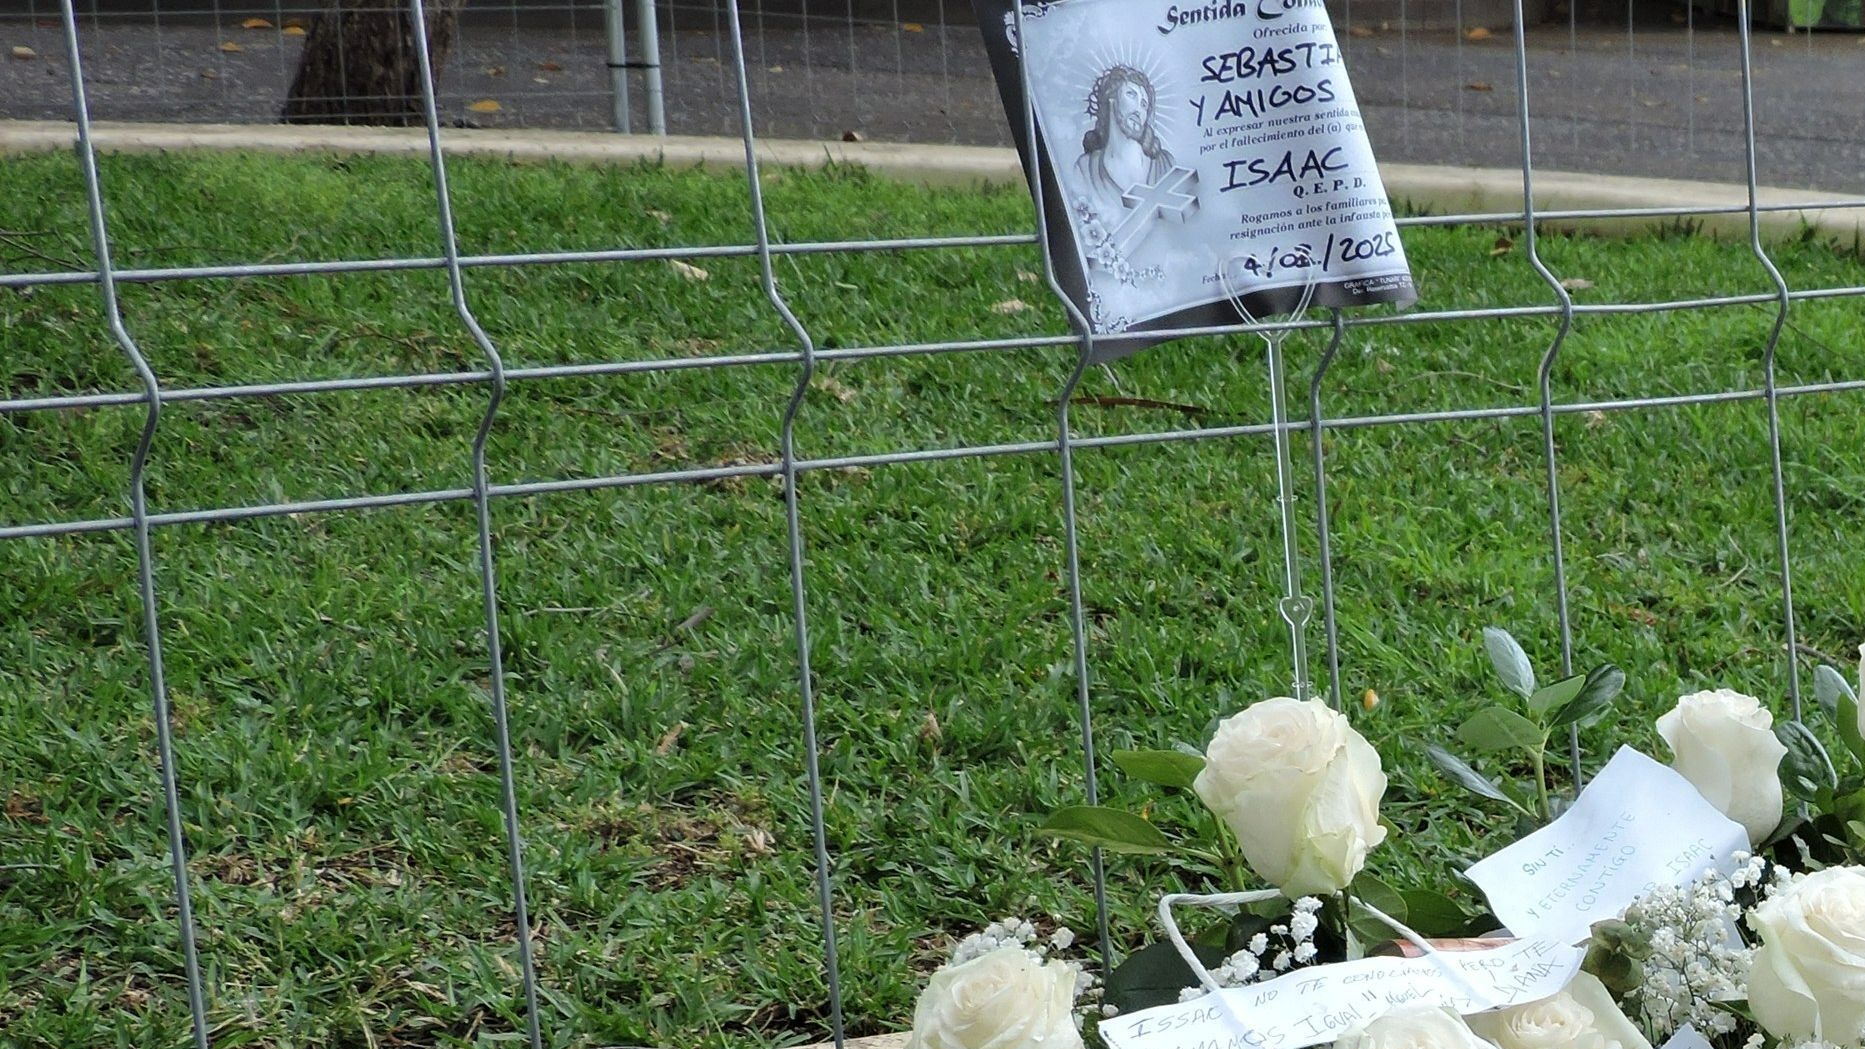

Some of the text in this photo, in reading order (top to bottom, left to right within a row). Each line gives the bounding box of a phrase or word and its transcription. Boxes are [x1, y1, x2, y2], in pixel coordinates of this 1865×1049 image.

[1157, 0, 1246, 35] Sentida
[1253, 23, 1308, 39] Ofrecida
[1189, 79, 1336, 127] Y AMIGOS
[1200, 143, 1216, 155] por
[1219, 139, 1228, 150] el
[1230, 128, 1305, 149] fallecimiento
[1308, 123, 1325, 136] del
[1327, 121, 1342, 135] (a)
[1203, 127, 1213, 138] Al
[1216, 121, 1264, 136] expresar
[1267, 114, 1311, 128] nuestra
[1314, 107, 1350, 121] sentida
[1219, 146, 1349, 193] ISAAC
[1229, 223, 1295, 240] resignación
[1298, 219, 1323, 229] ante
[1325, 216, 1337, 226] la
[1340, 210, 1381, 222] infausta
[1240, 210, 1293, 225] Rogamos
[1296, 208, 1303, 216] a
[1306, 204, 1322, 214] los
[1325, 197, 1377, 212] familiares
[1665, 838, 1713, 877] ISAAC
[1254, 988, 1279, 1008] NO
[1295, 976, 1329, 995] TE
[1512, 939, 1562, 959] TE
